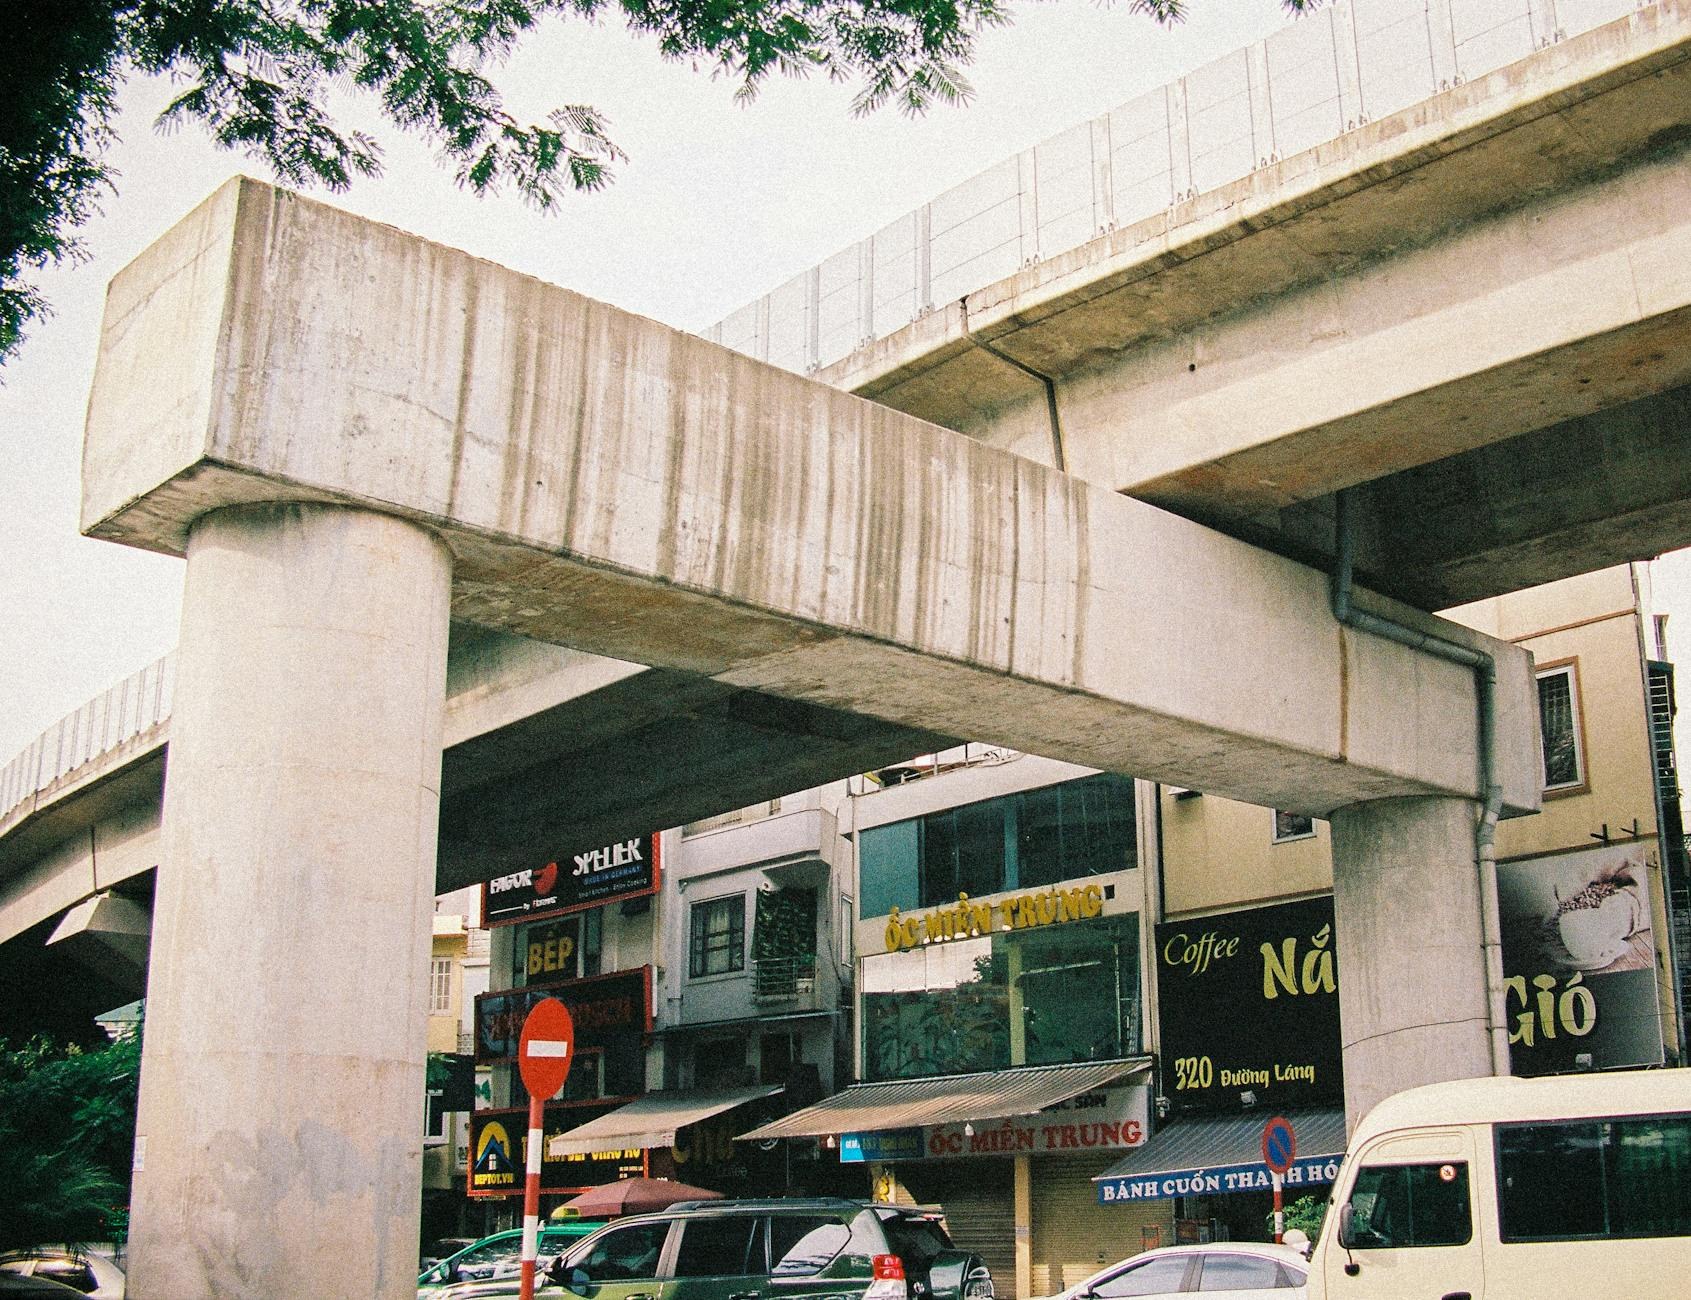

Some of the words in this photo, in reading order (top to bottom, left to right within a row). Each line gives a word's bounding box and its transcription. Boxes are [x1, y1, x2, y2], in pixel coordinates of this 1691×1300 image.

[490, 869, 533, 894] FAGOR
[885, 906, 920, 952] ỐC
[1001, 885, 1102, 929] TRUNG
[1164, 931, 1240, 977] Coffee
[1260, 923, 1337, 999] Nắ
[1503, 971, 1597, 1047] Gió
[1175, 1056, 1214, 1091] 320
[1221, 1068, 1270, 1088] Đường
[1274, 1064, 1315, 1084] Láng
[928, 1125, 963, 1156] ỐC
[1043, 1120, 1142, 1149] TRUNG
[1103, 1178, 1158, 1201] BÁNH
[1162, 1170, 1220, 1195] CUỐN
[1306, 1159, 1340, 1183] HÓ
